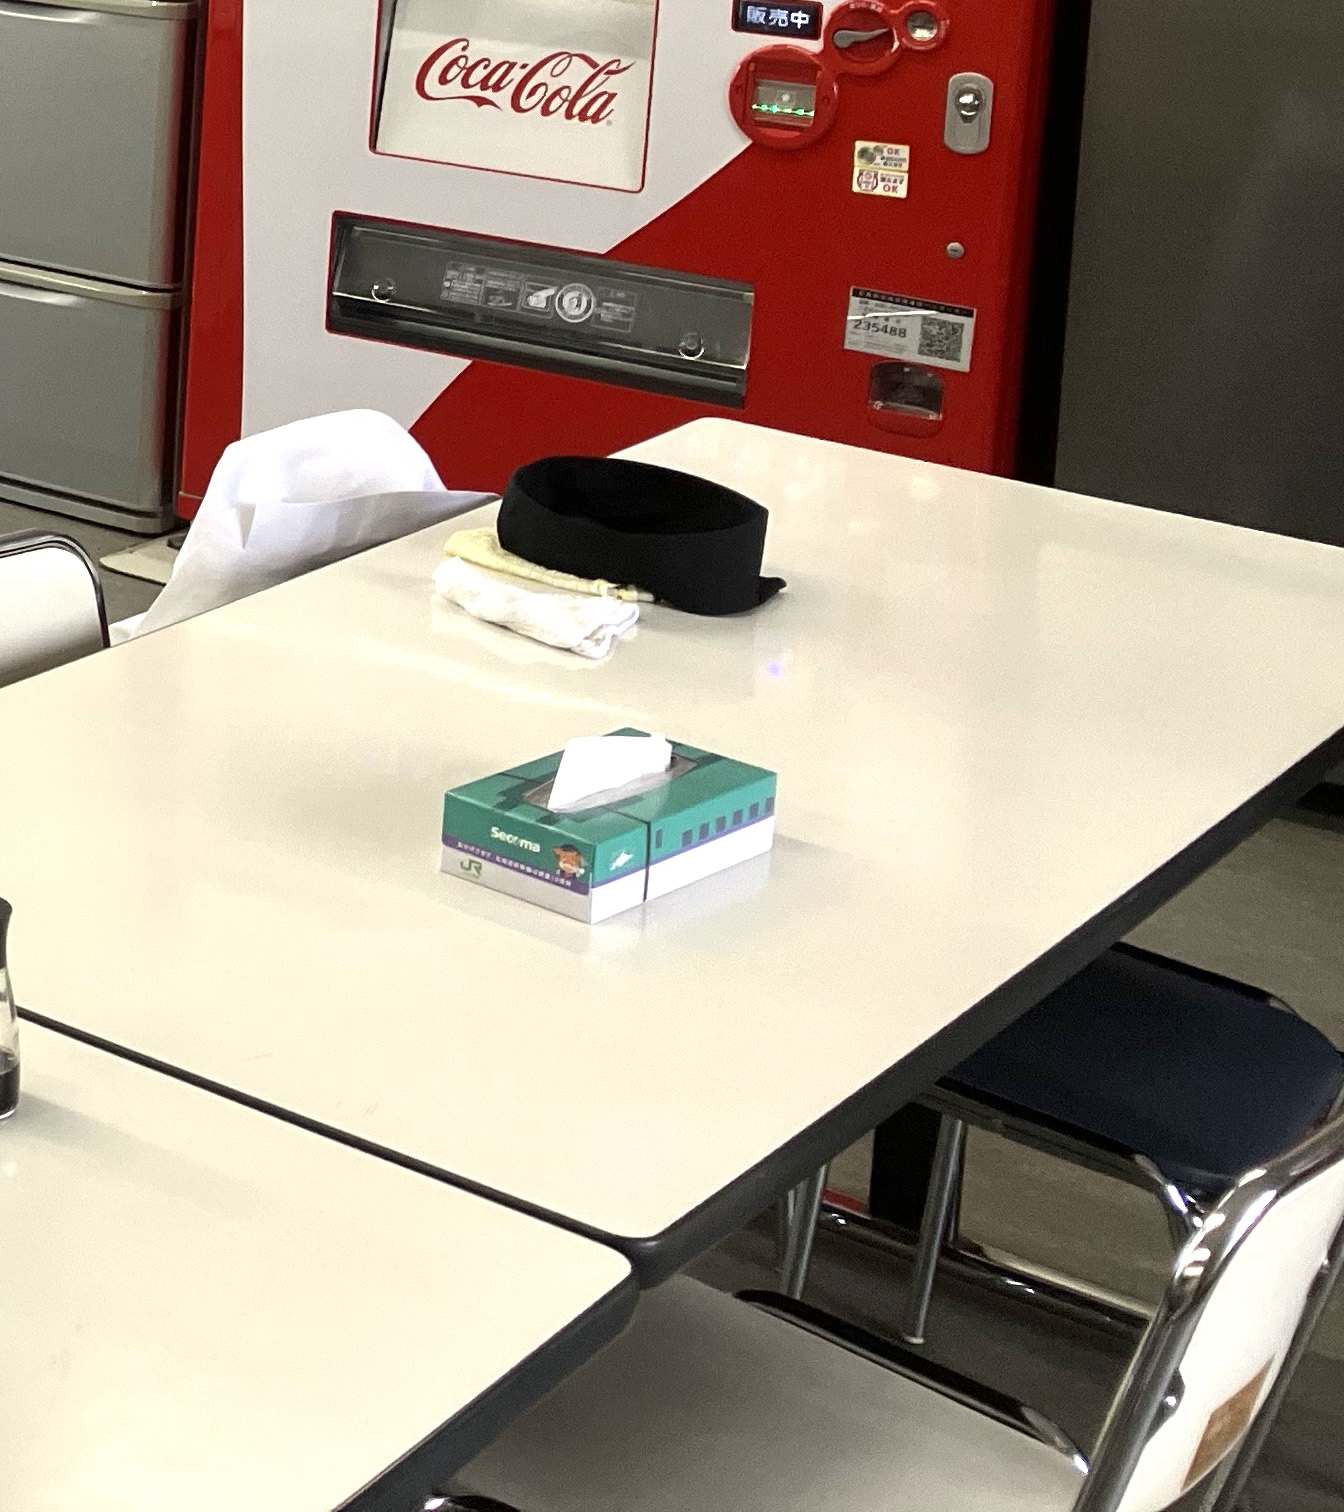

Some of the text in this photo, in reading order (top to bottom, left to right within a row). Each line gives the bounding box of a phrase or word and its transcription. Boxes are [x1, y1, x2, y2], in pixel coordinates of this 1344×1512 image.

[746, 4, 811, 30] 販売中
[415, 38, 636, 124] Coca-Cola
[853, 319, 907, 338] 235488
[460, 859, 483, 879] JR
